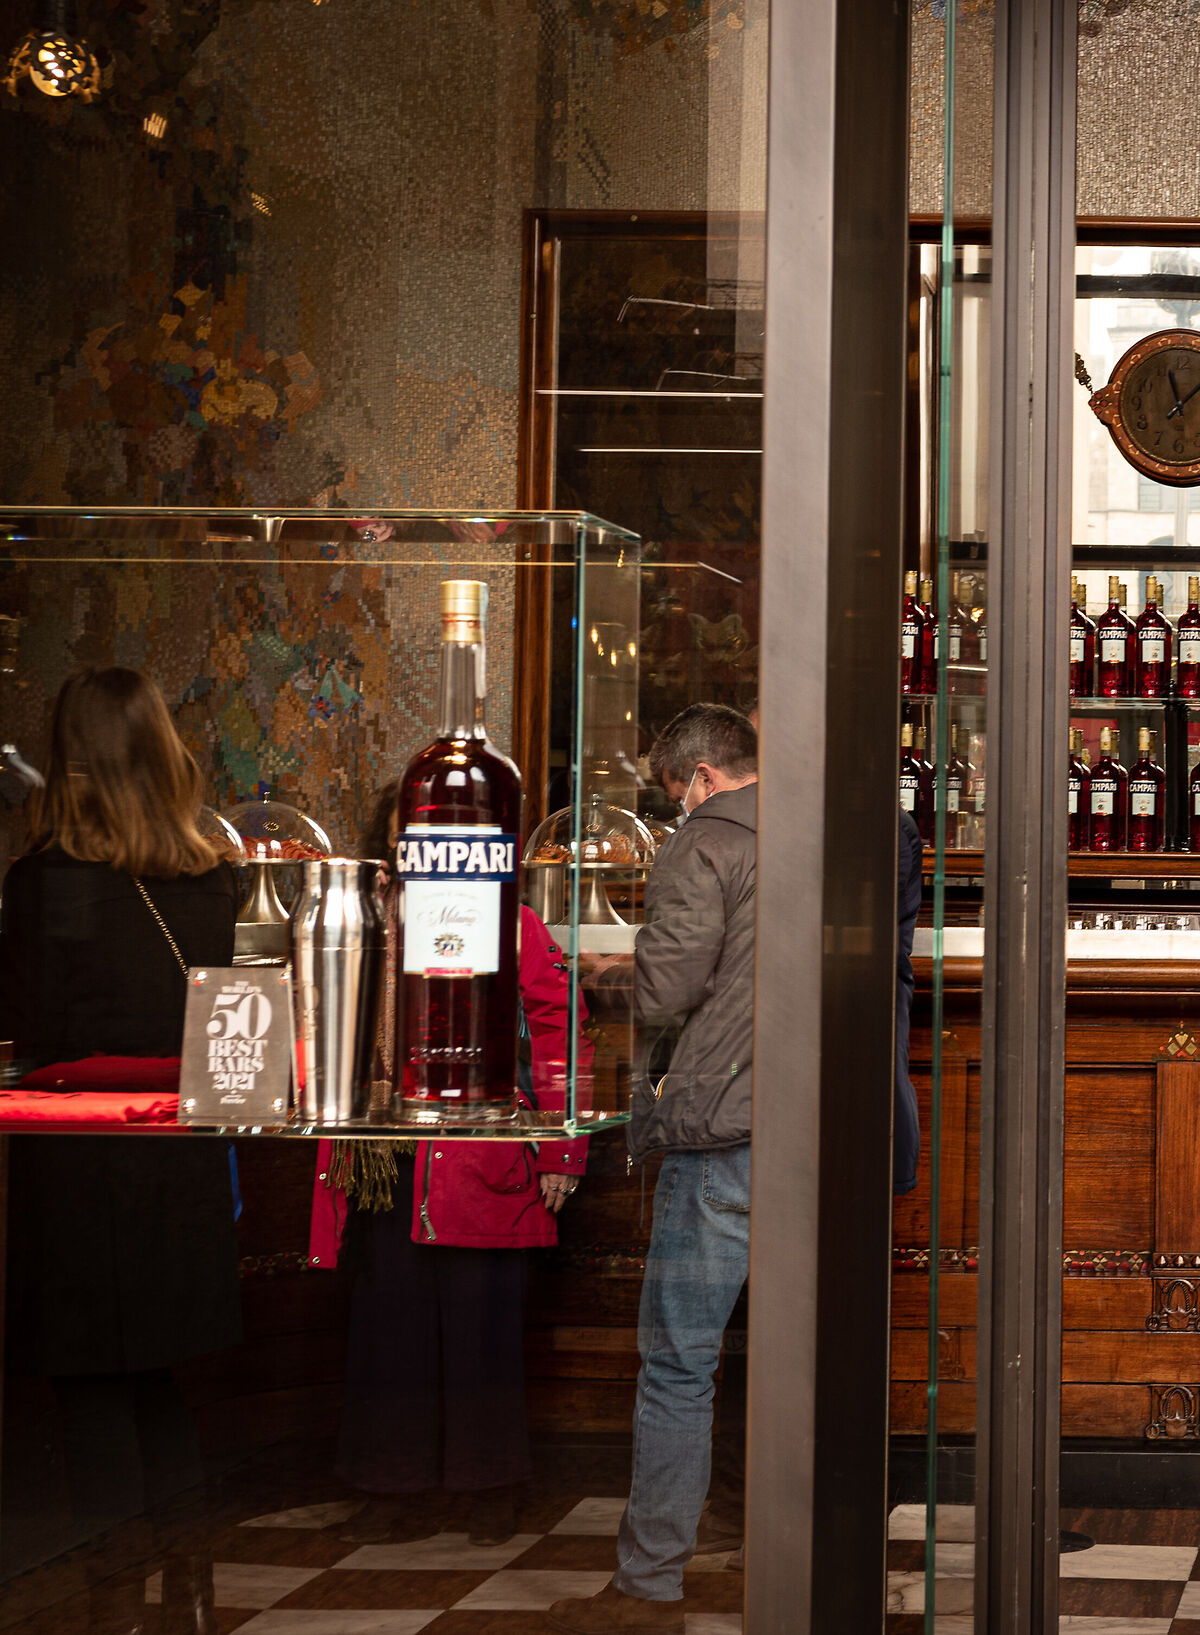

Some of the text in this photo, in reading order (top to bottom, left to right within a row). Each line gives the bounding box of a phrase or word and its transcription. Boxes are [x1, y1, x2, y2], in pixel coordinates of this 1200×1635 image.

[1136, 415, 1148, 431] 8
[1153, 431, 1164, 446] 7
[1173, 438, 1184, 454] 6
[902, 626, 919, 635] PARI
[1070, 630, 1087, 639] PARI
[900, 779, 919, 788] PARI
[397, 841, 514, 873] CAMPARI
[206, 994, 273, 1040] 50
[208, 1039, 268, 1057] BEST
[208, 1056, 265, 1072] BARS
[212, 1072, 255, 1090] 2021
